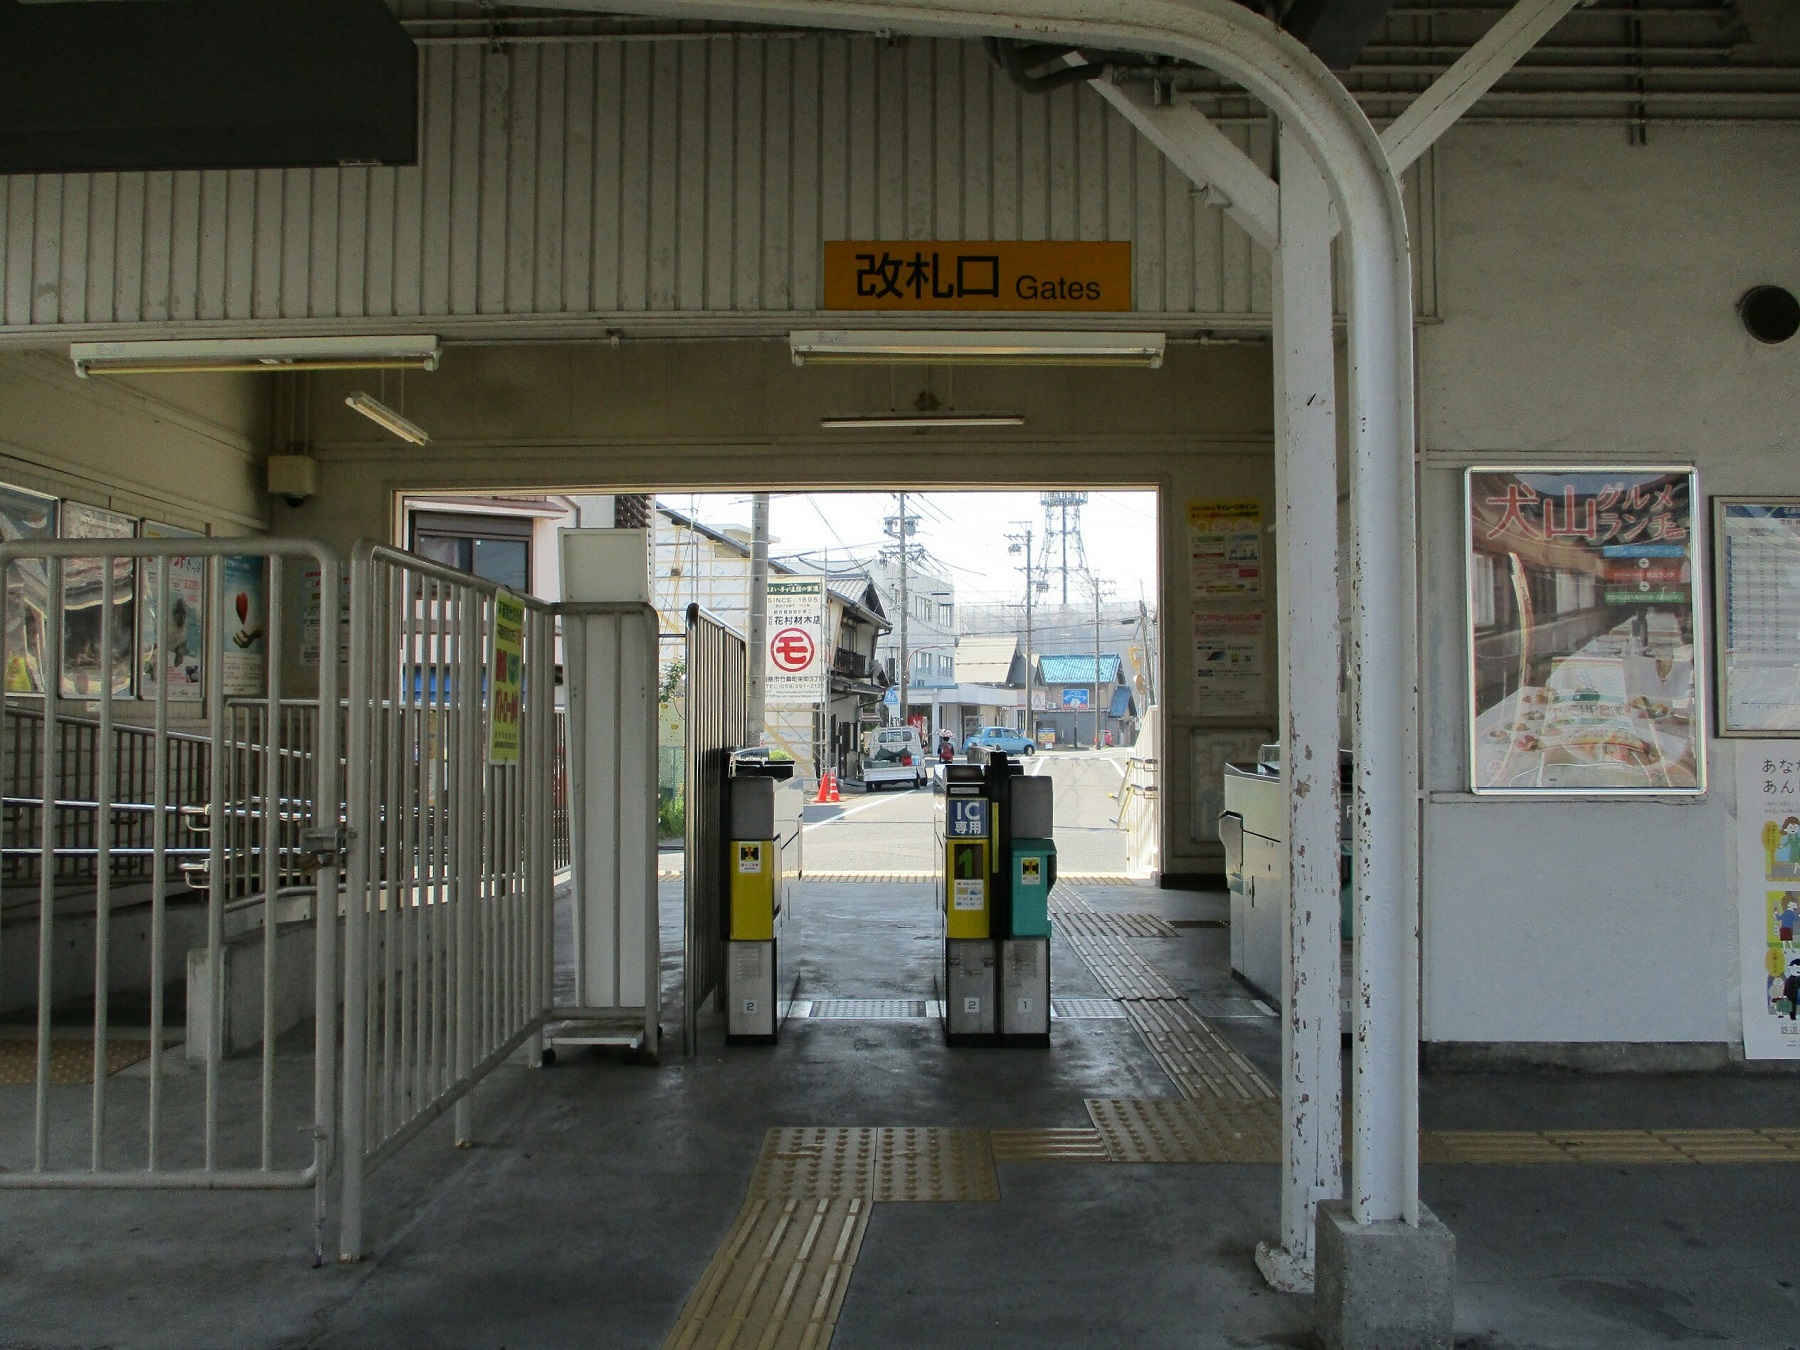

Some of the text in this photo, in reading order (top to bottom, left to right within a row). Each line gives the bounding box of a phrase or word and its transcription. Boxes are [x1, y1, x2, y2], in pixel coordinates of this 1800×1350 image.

[856, 252, 1101, 300] 改札口 Gates
[1486, 482, 1674, 540] 犬山 グルメ
[1600, 512, 1677, 541] ランチ
[774, 615, 820, 626] 花村材木店
[1763, 779, 1800, 795] あん
[957, 802, 980, 820] IC
[955, 821, 981, 834] 専用
[746, 1001, 754, 1011] 2
[968, 1001, 976, 1009] 2
